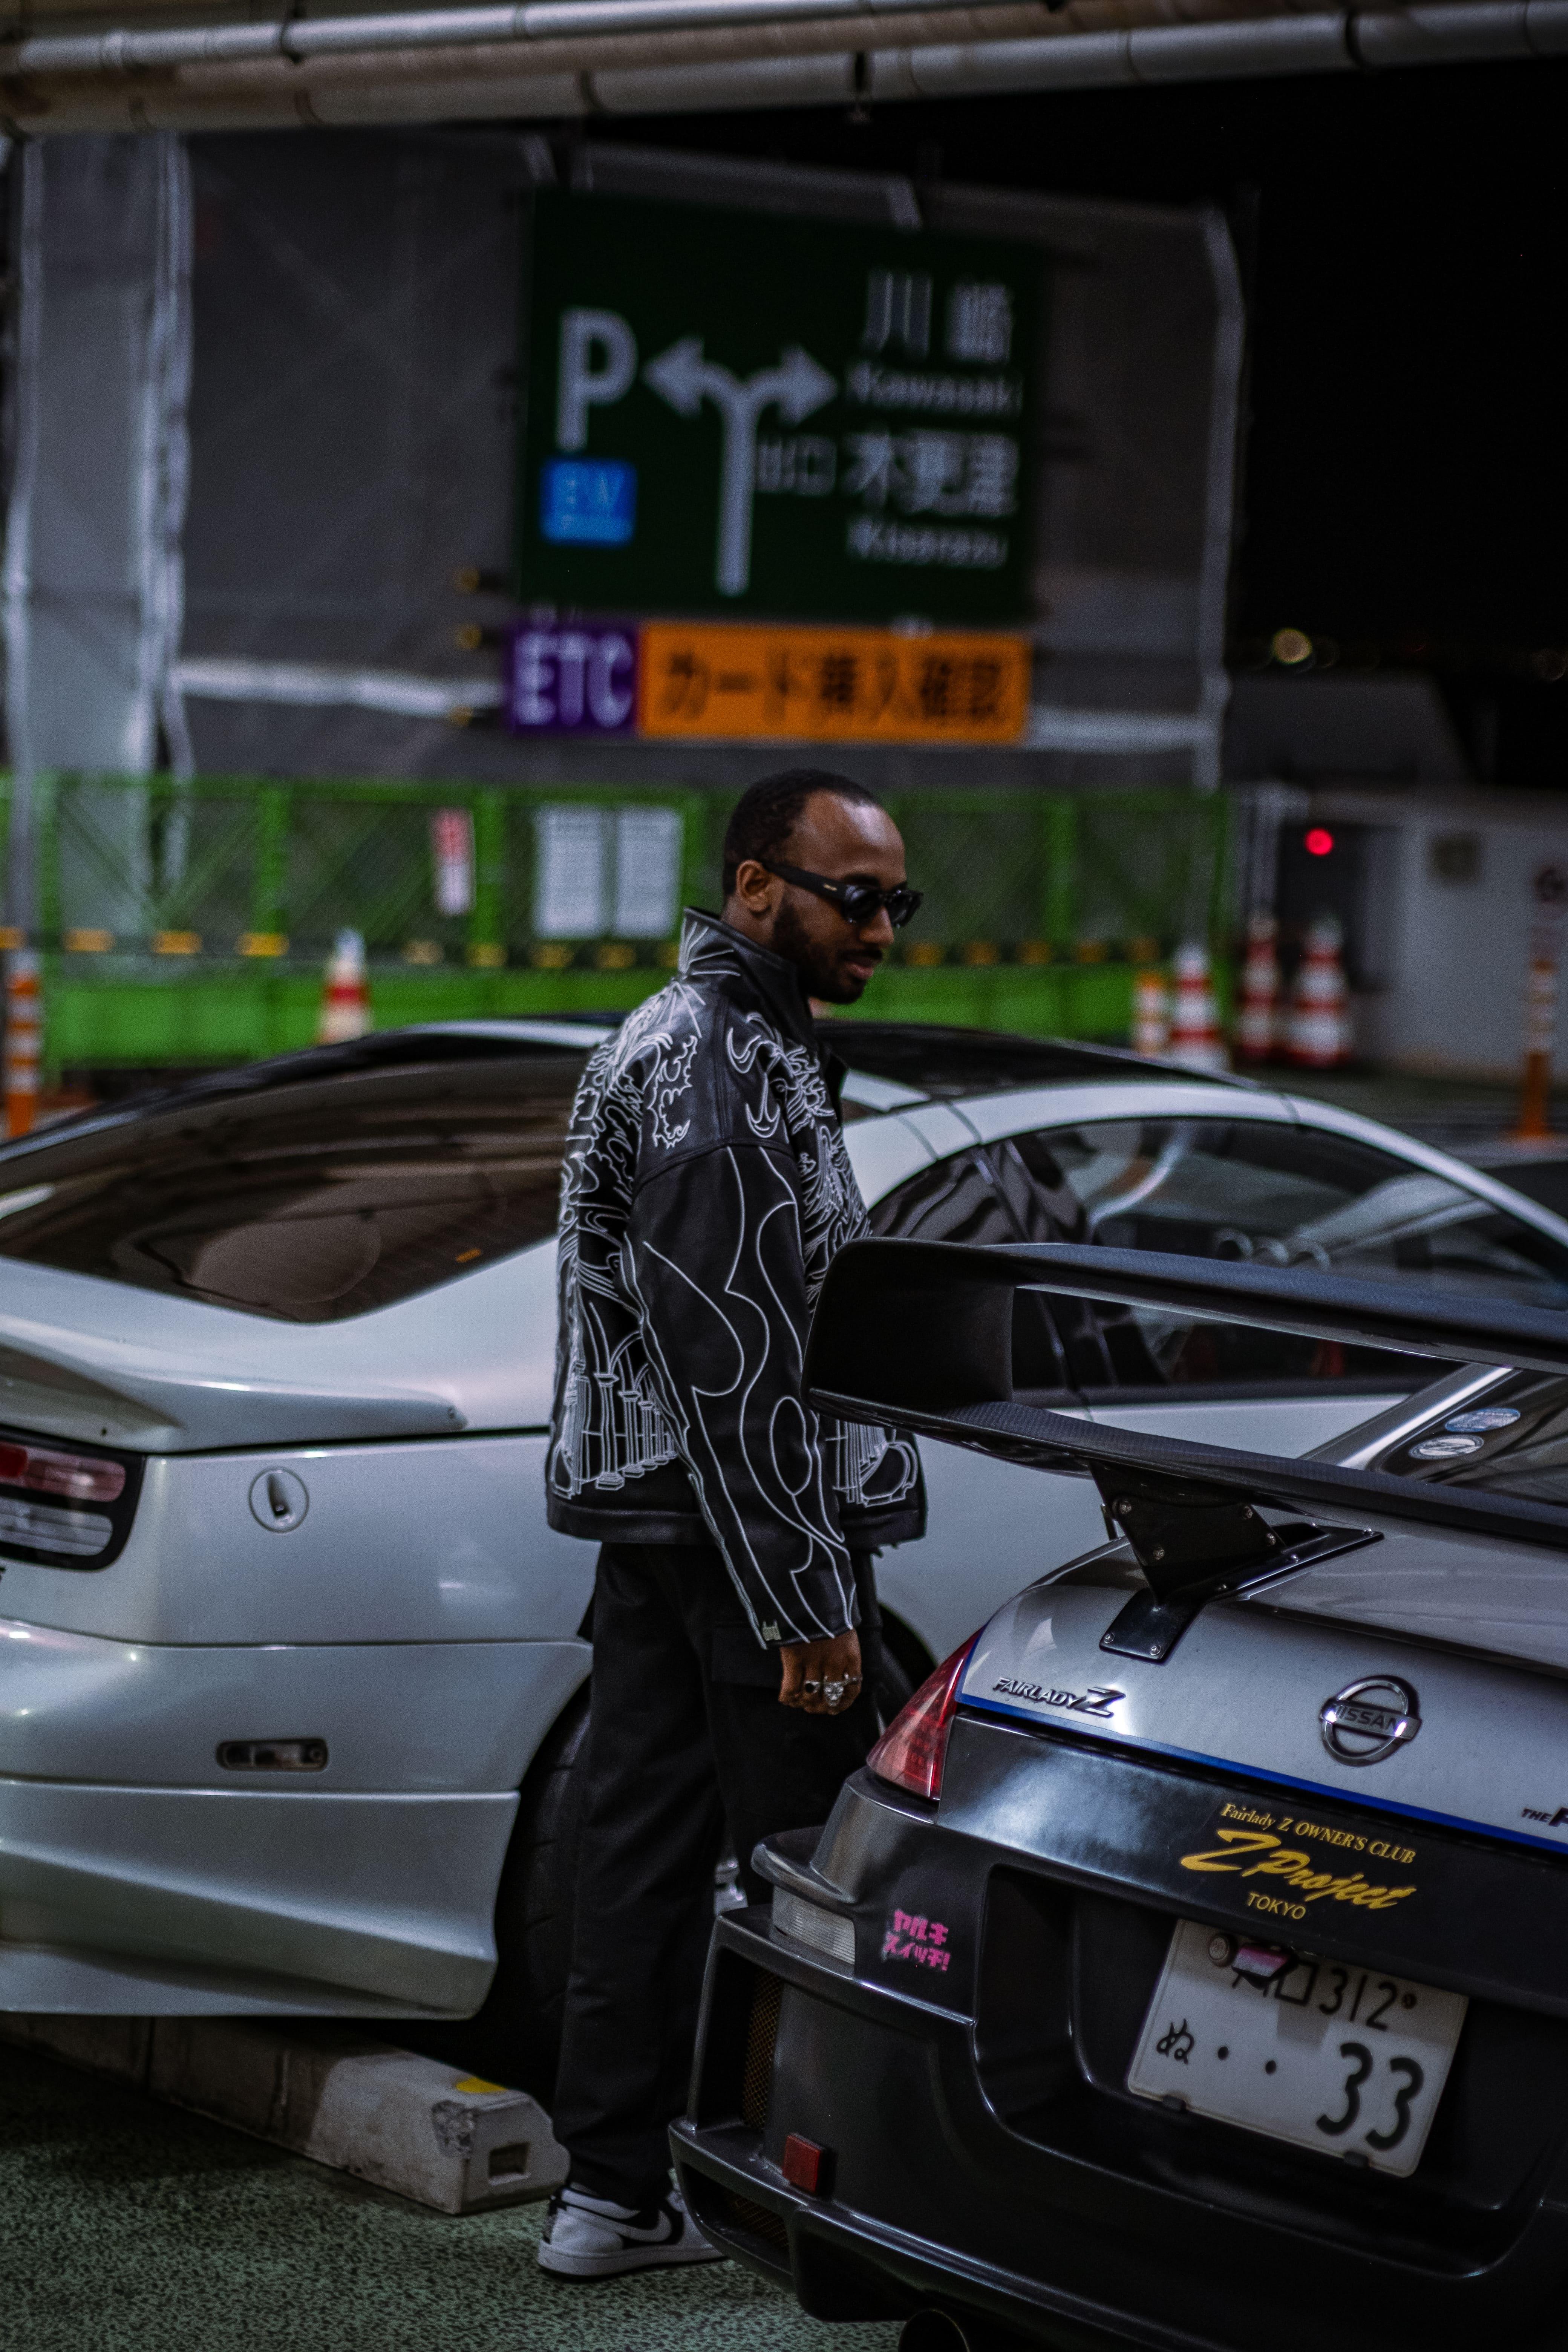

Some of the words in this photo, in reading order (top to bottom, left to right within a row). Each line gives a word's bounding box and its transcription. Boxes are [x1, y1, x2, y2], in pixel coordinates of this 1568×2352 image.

[557, 307, 639, 452] P
[512, 632, 633, 727] ETC
[992, 1677, 1082, 1709] FAIRLADY
[1220, 1803, 1276, 1830] Fairlady
[1277, 1818, 1294, 1831] Z
[1295, 1822, 1367, 1851] OWNER'S
[1369, 1841, 1416, 1864] CLUB
[1521, 1808, 1553, 1823] THE
[1242, 1850, 1416, 1909] Project
[1248, 1890, 1306, 1920] TOKYO
[1319, 1968, 1396, 2031] 312
[1156, 2018, 1195, 2065] ぬ
